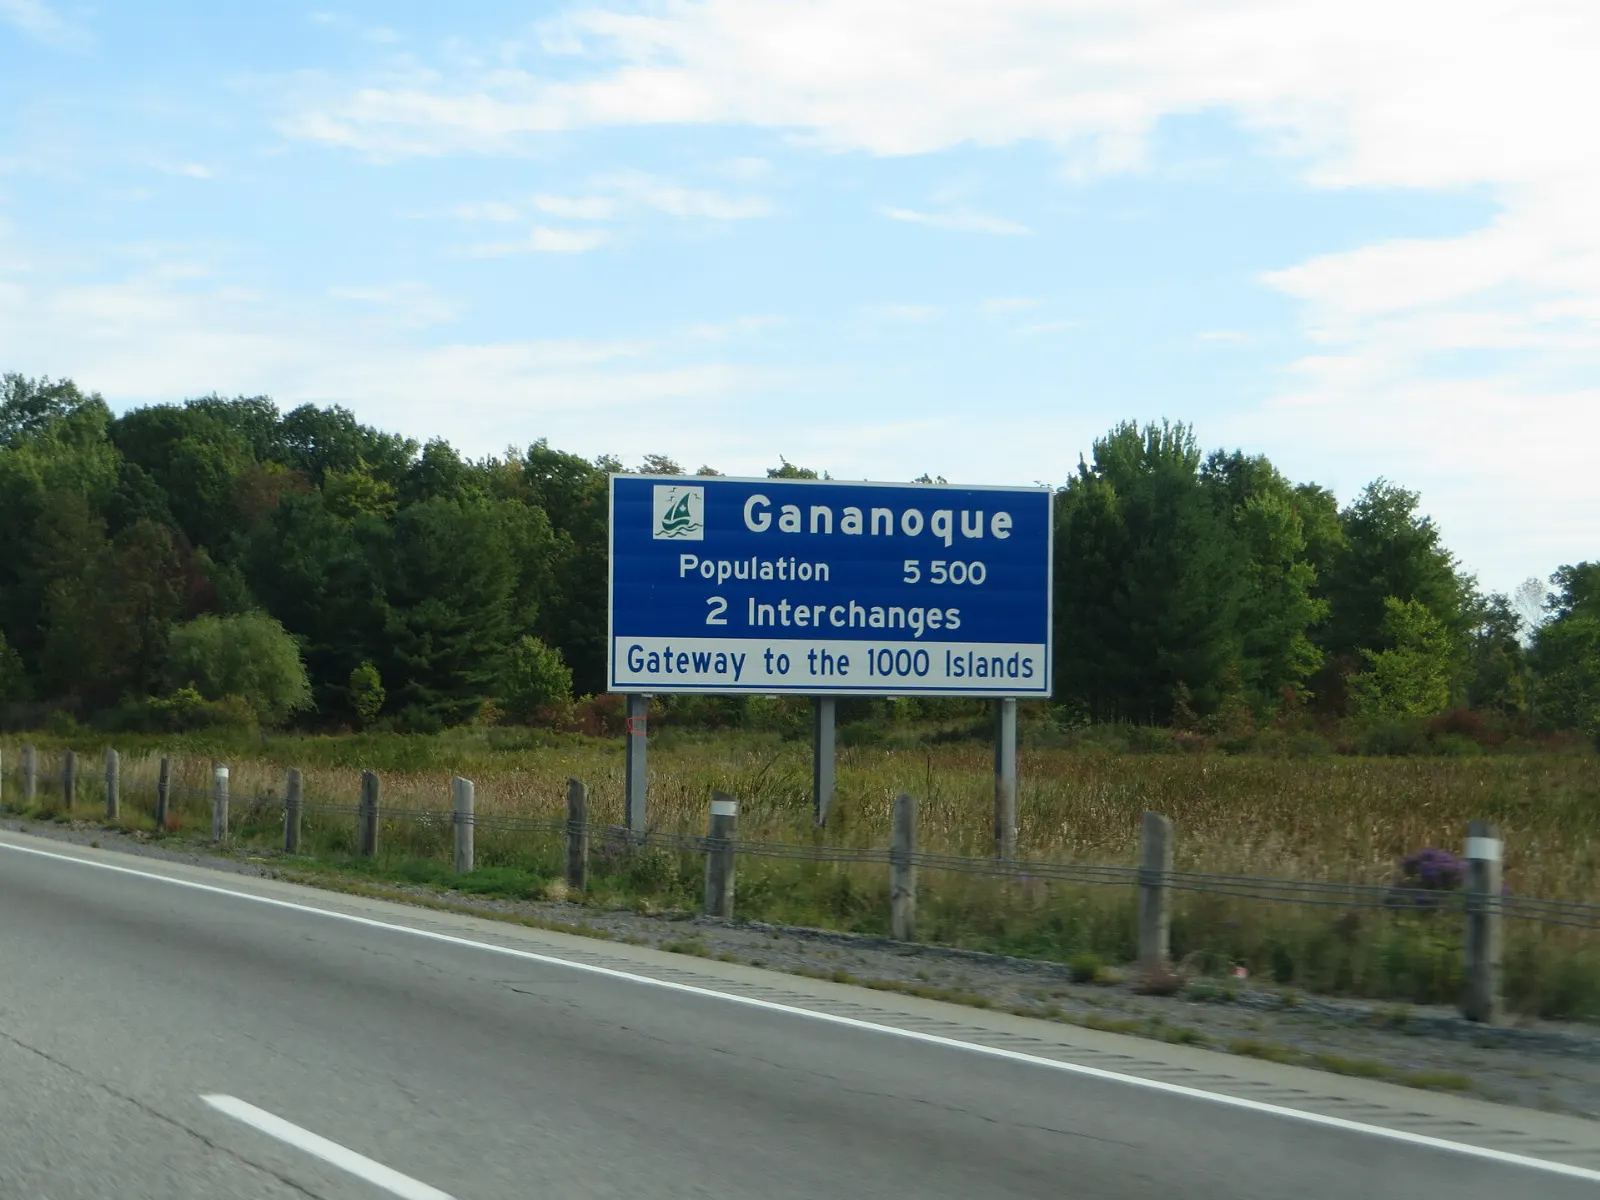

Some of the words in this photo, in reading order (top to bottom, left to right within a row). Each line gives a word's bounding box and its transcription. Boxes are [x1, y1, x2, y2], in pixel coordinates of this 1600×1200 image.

[743, 495, 1013, 547] Gananoque
[681, 555, 828, 584] Population
[707, 597, 727, 624] 2
[748, 598, 961, 638] Interchanges
[627, 645, 746, 681] Gateway
[764, 648, 790, 674] to
[808, 648, 849, 675] the
[868, 649, 929, 676] 1000
[946, 650, 1033, 678] Islands
